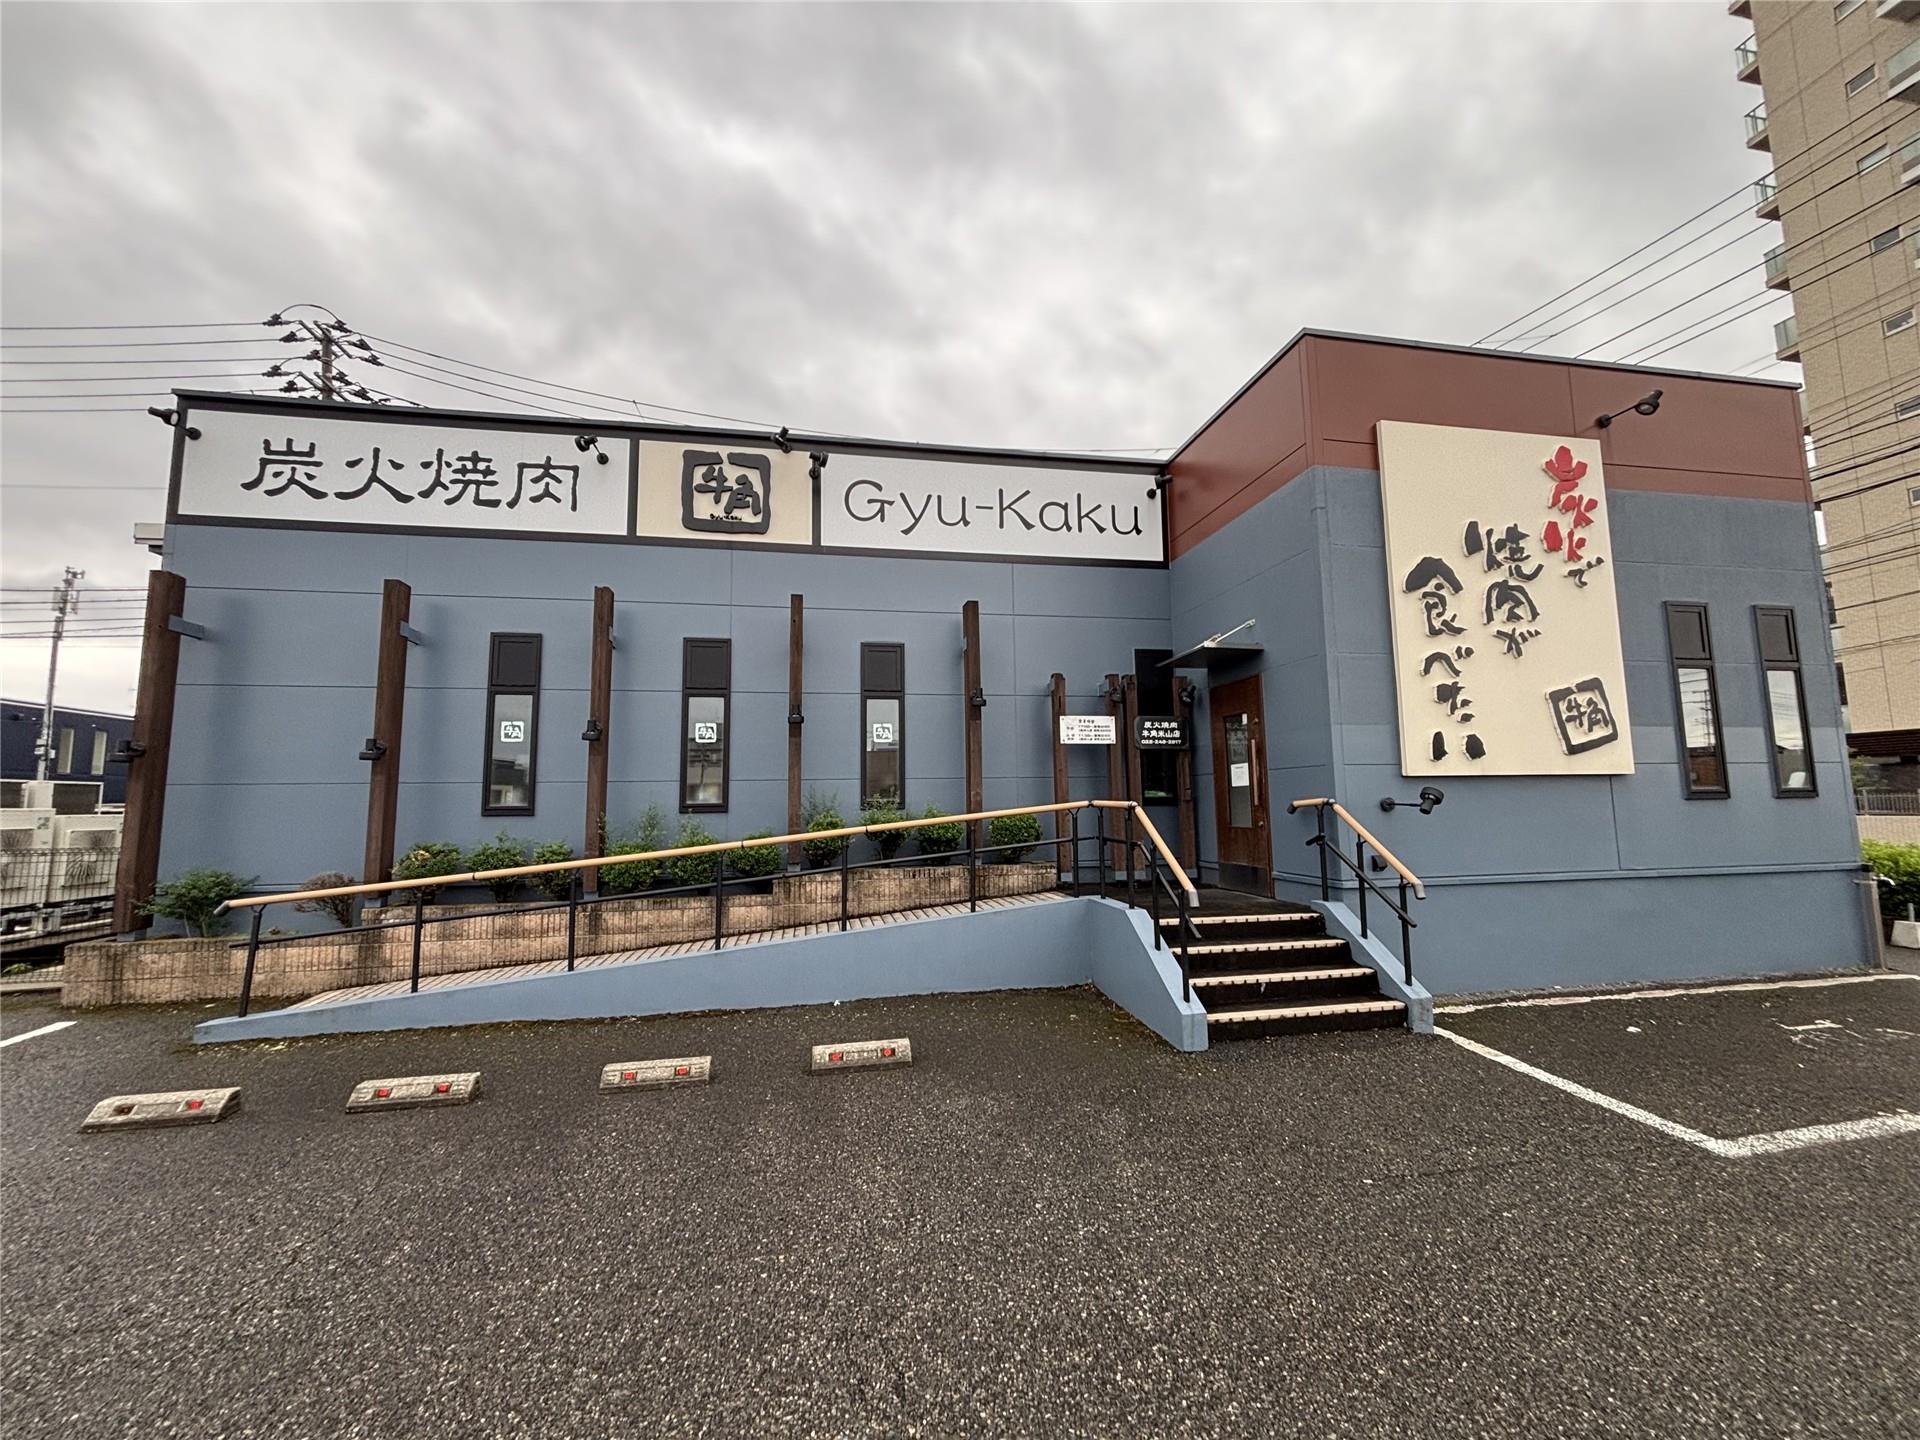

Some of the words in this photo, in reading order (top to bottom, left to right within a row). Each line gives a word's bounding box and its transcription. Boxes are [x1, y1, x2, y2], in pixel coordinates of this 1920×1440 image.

[240, 437, 580, 512] 炭火焼肉
[694, 465, 762, 517] 牛角
[843, 478, 1144, 536] Gyu-Kaku
[1463, 520, 1545, 659] 焼肉が
[1403, 556, 1487, 763] 食べたい
[1564, 697, 1610, 735] 牛角
